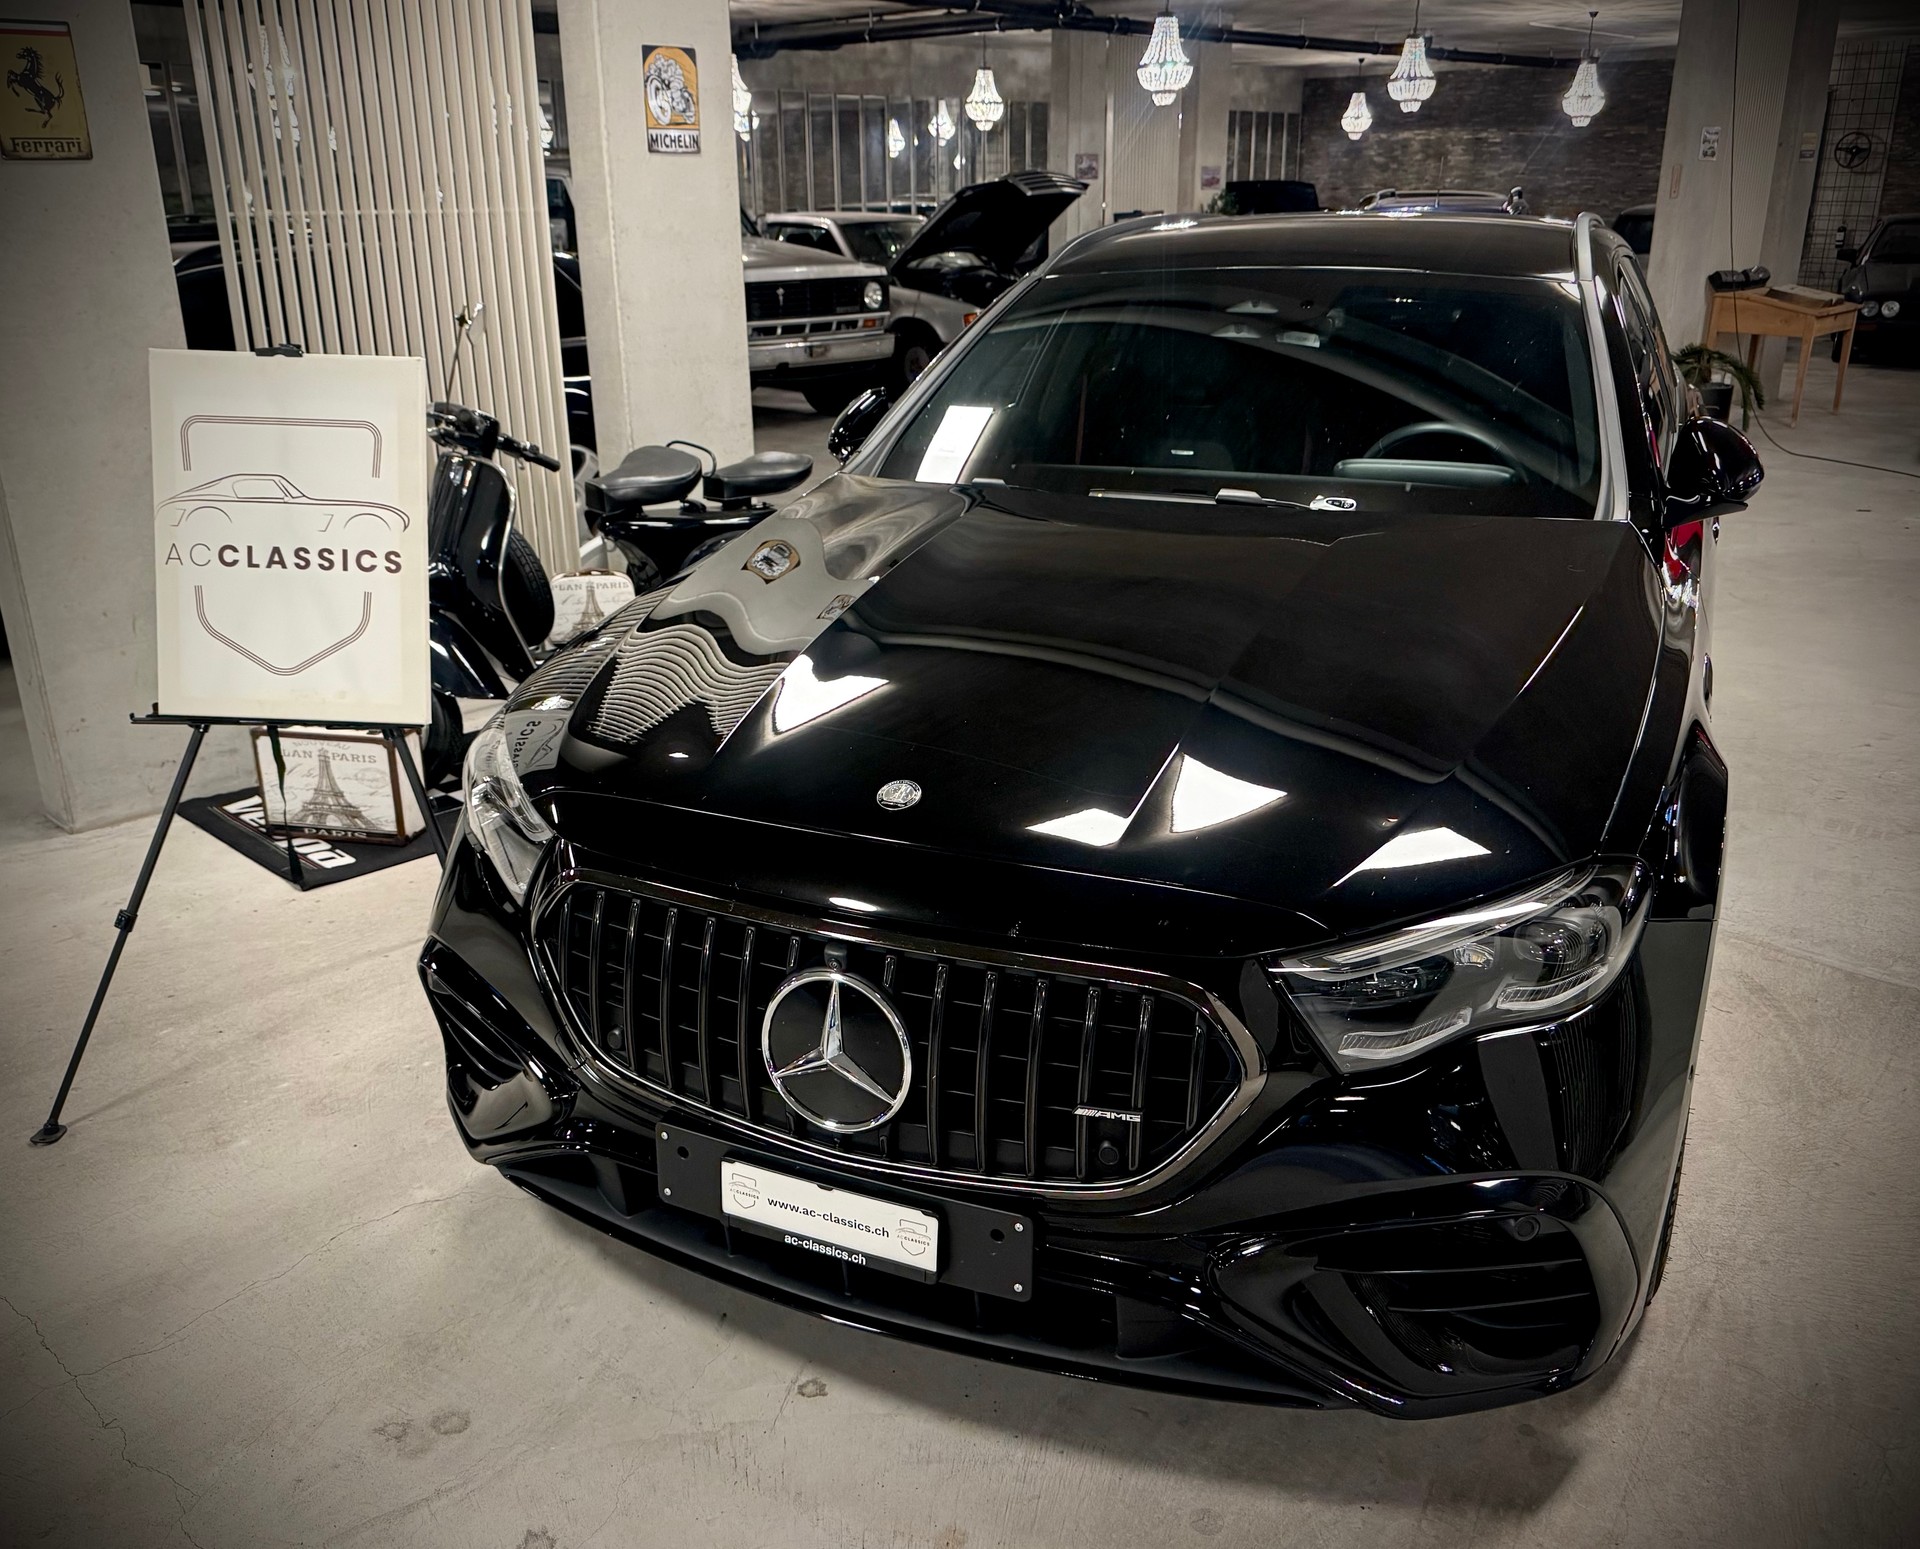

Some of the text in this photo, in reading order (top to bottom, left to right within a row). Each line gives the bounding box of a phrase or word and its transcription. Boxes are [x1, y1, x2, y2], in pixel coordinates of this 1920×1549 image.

[10, 137, 83, 153] Ferrari
[650, 133, 699, 149] MICHELIN
[596, 582, 629, 590] PARIS
[281, 748, 377, 764] LAN PARIS
[303, 828, 367, 839] PARIS
[767, 1196, 890, 1238] www.ac-classics.ch
[784, 1233, 867, 1265] ac-classics.ch
